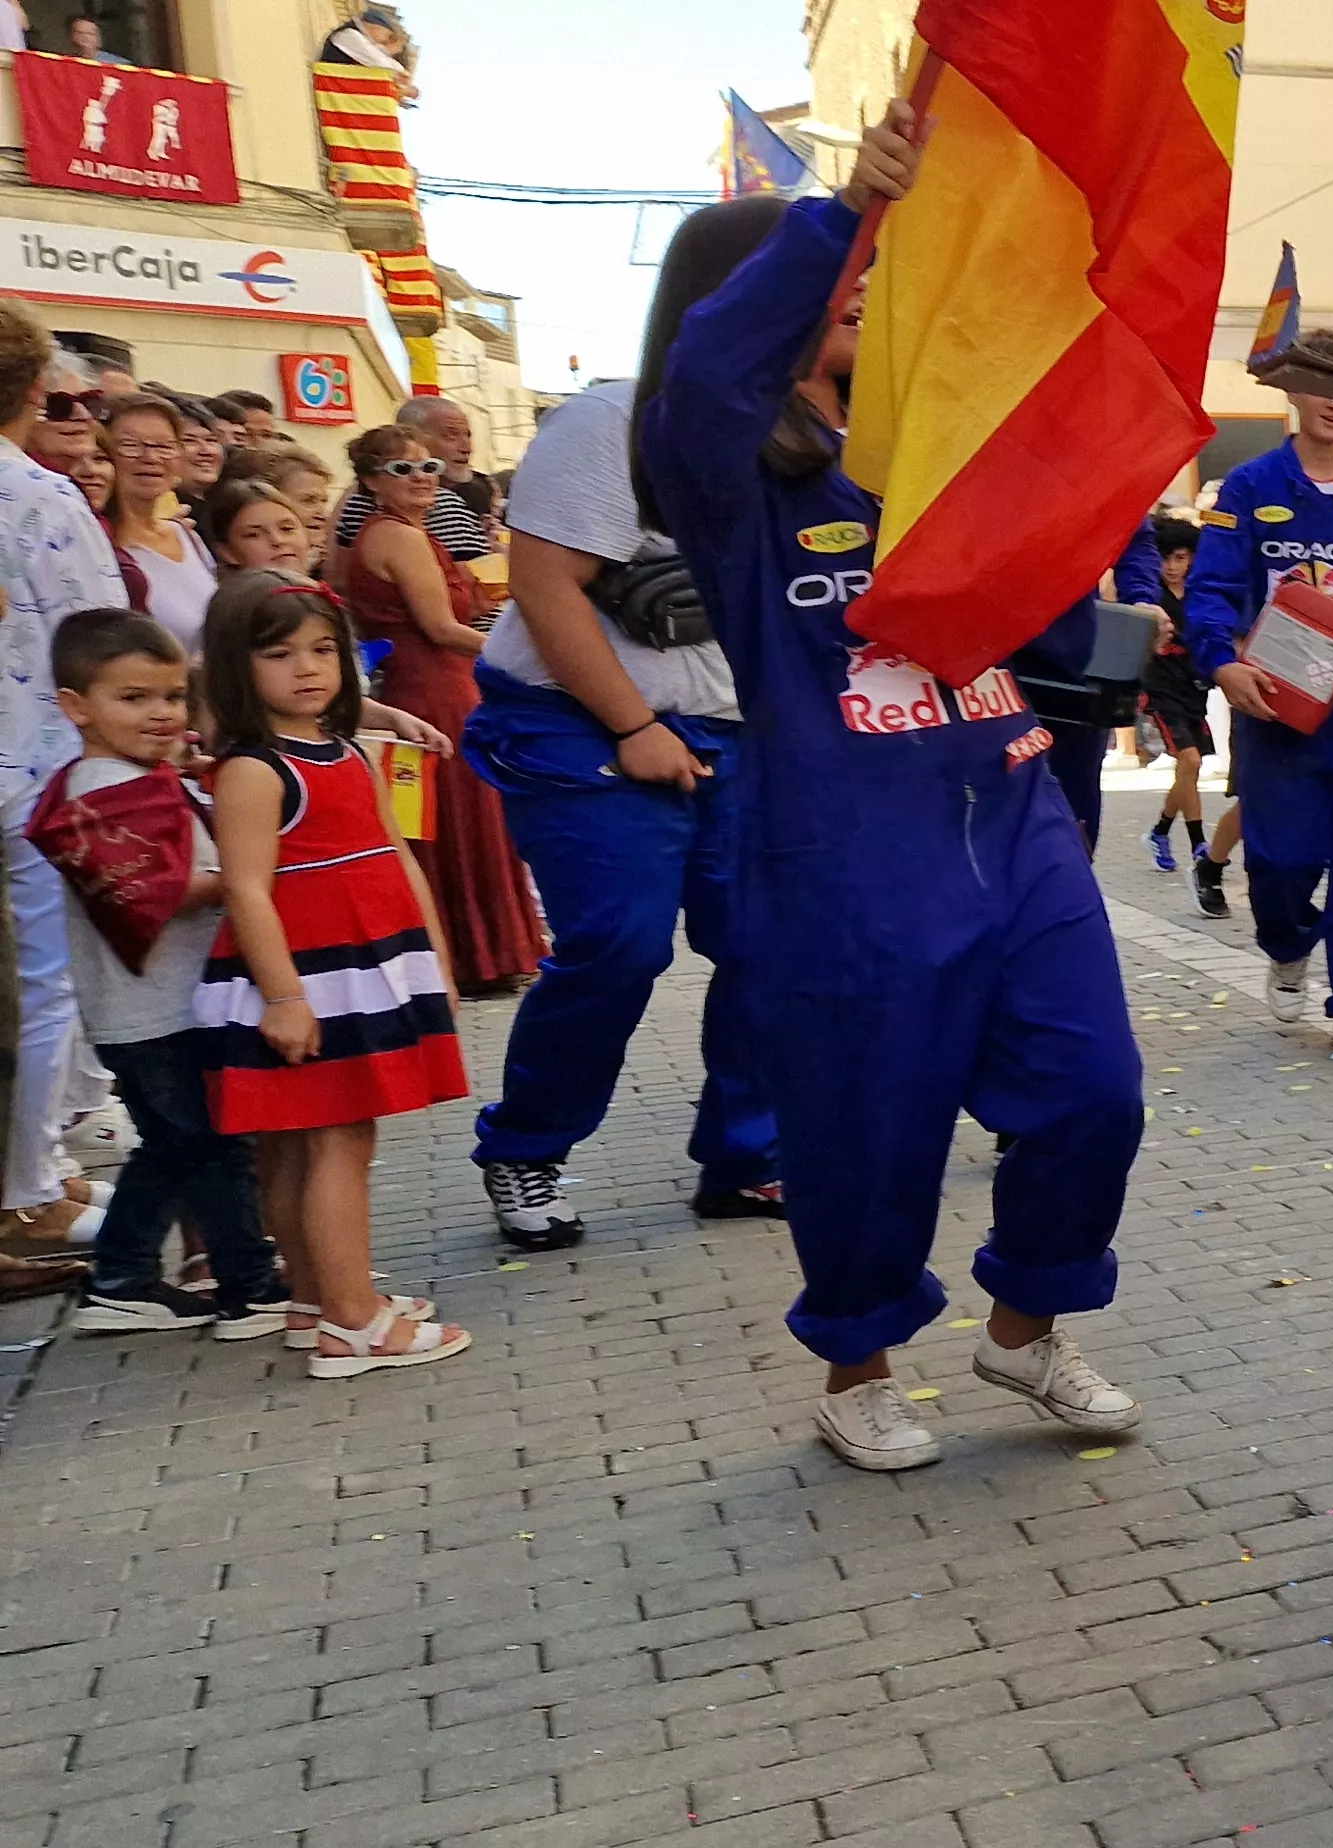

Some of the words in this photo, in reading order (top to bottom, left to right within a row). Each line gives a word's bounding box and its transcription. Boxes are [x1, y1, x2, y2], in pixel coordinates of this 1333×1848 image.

[20, 234, 202, 291] iberCaja
[786, 570, 874, 608] OR
[839, 683, 942, 733] Red
[962, 672, 1027, 720] Bull
